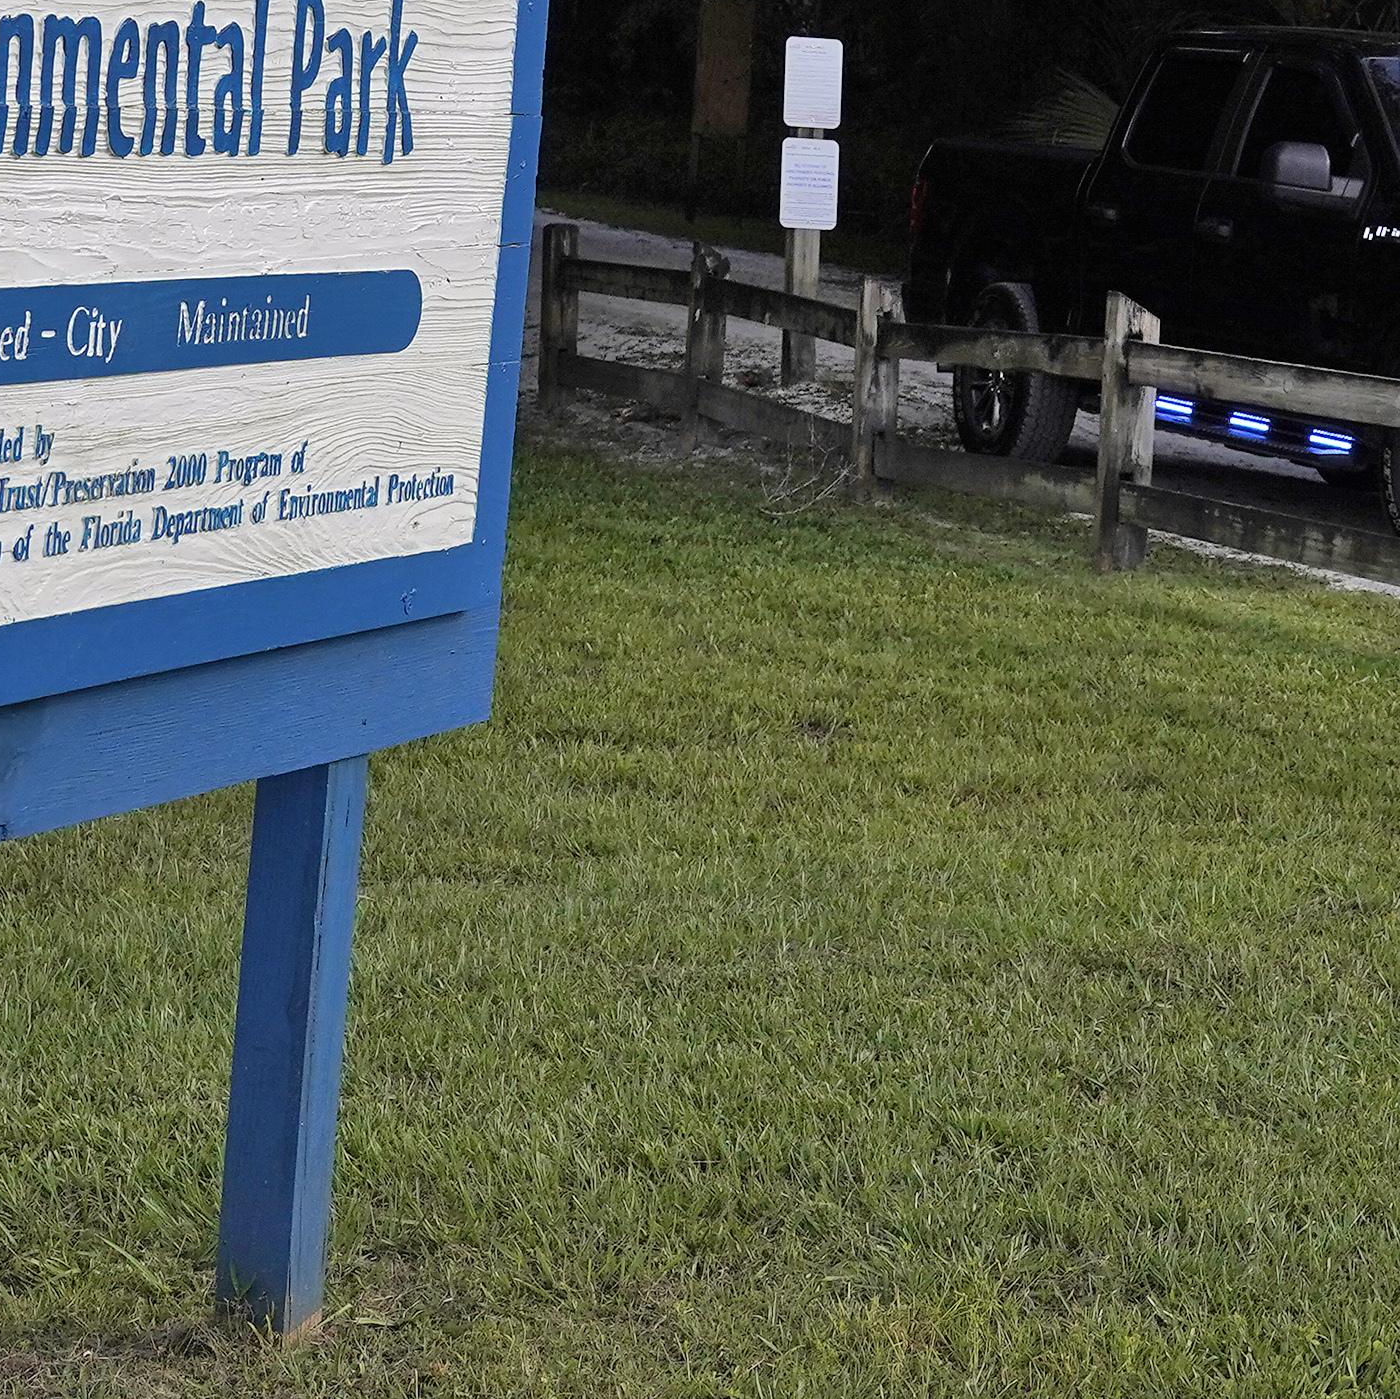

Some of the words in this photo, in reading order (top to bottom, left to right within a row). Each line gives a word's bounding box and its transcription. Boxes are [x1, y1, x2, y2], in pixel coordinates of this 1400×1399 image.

[67, 305, 123, 363] City
[176, 294, 311, 348] Maintained
[35, 424, 55, 466] by
[162, 452, 208, 491] 2000
[213, 450, 282, 487] Program
[290, 440, 309, 474] of
[12, 524, 35, 562] of
[42, 521, 72, 557] the
[80, 511, 142, 550] Florida
[151, 498, 244, 545] Department
[252, 491, 270, 524] of
[278, 475, 380, 521] Environmental
[385, 467, 455, 506] Protection
